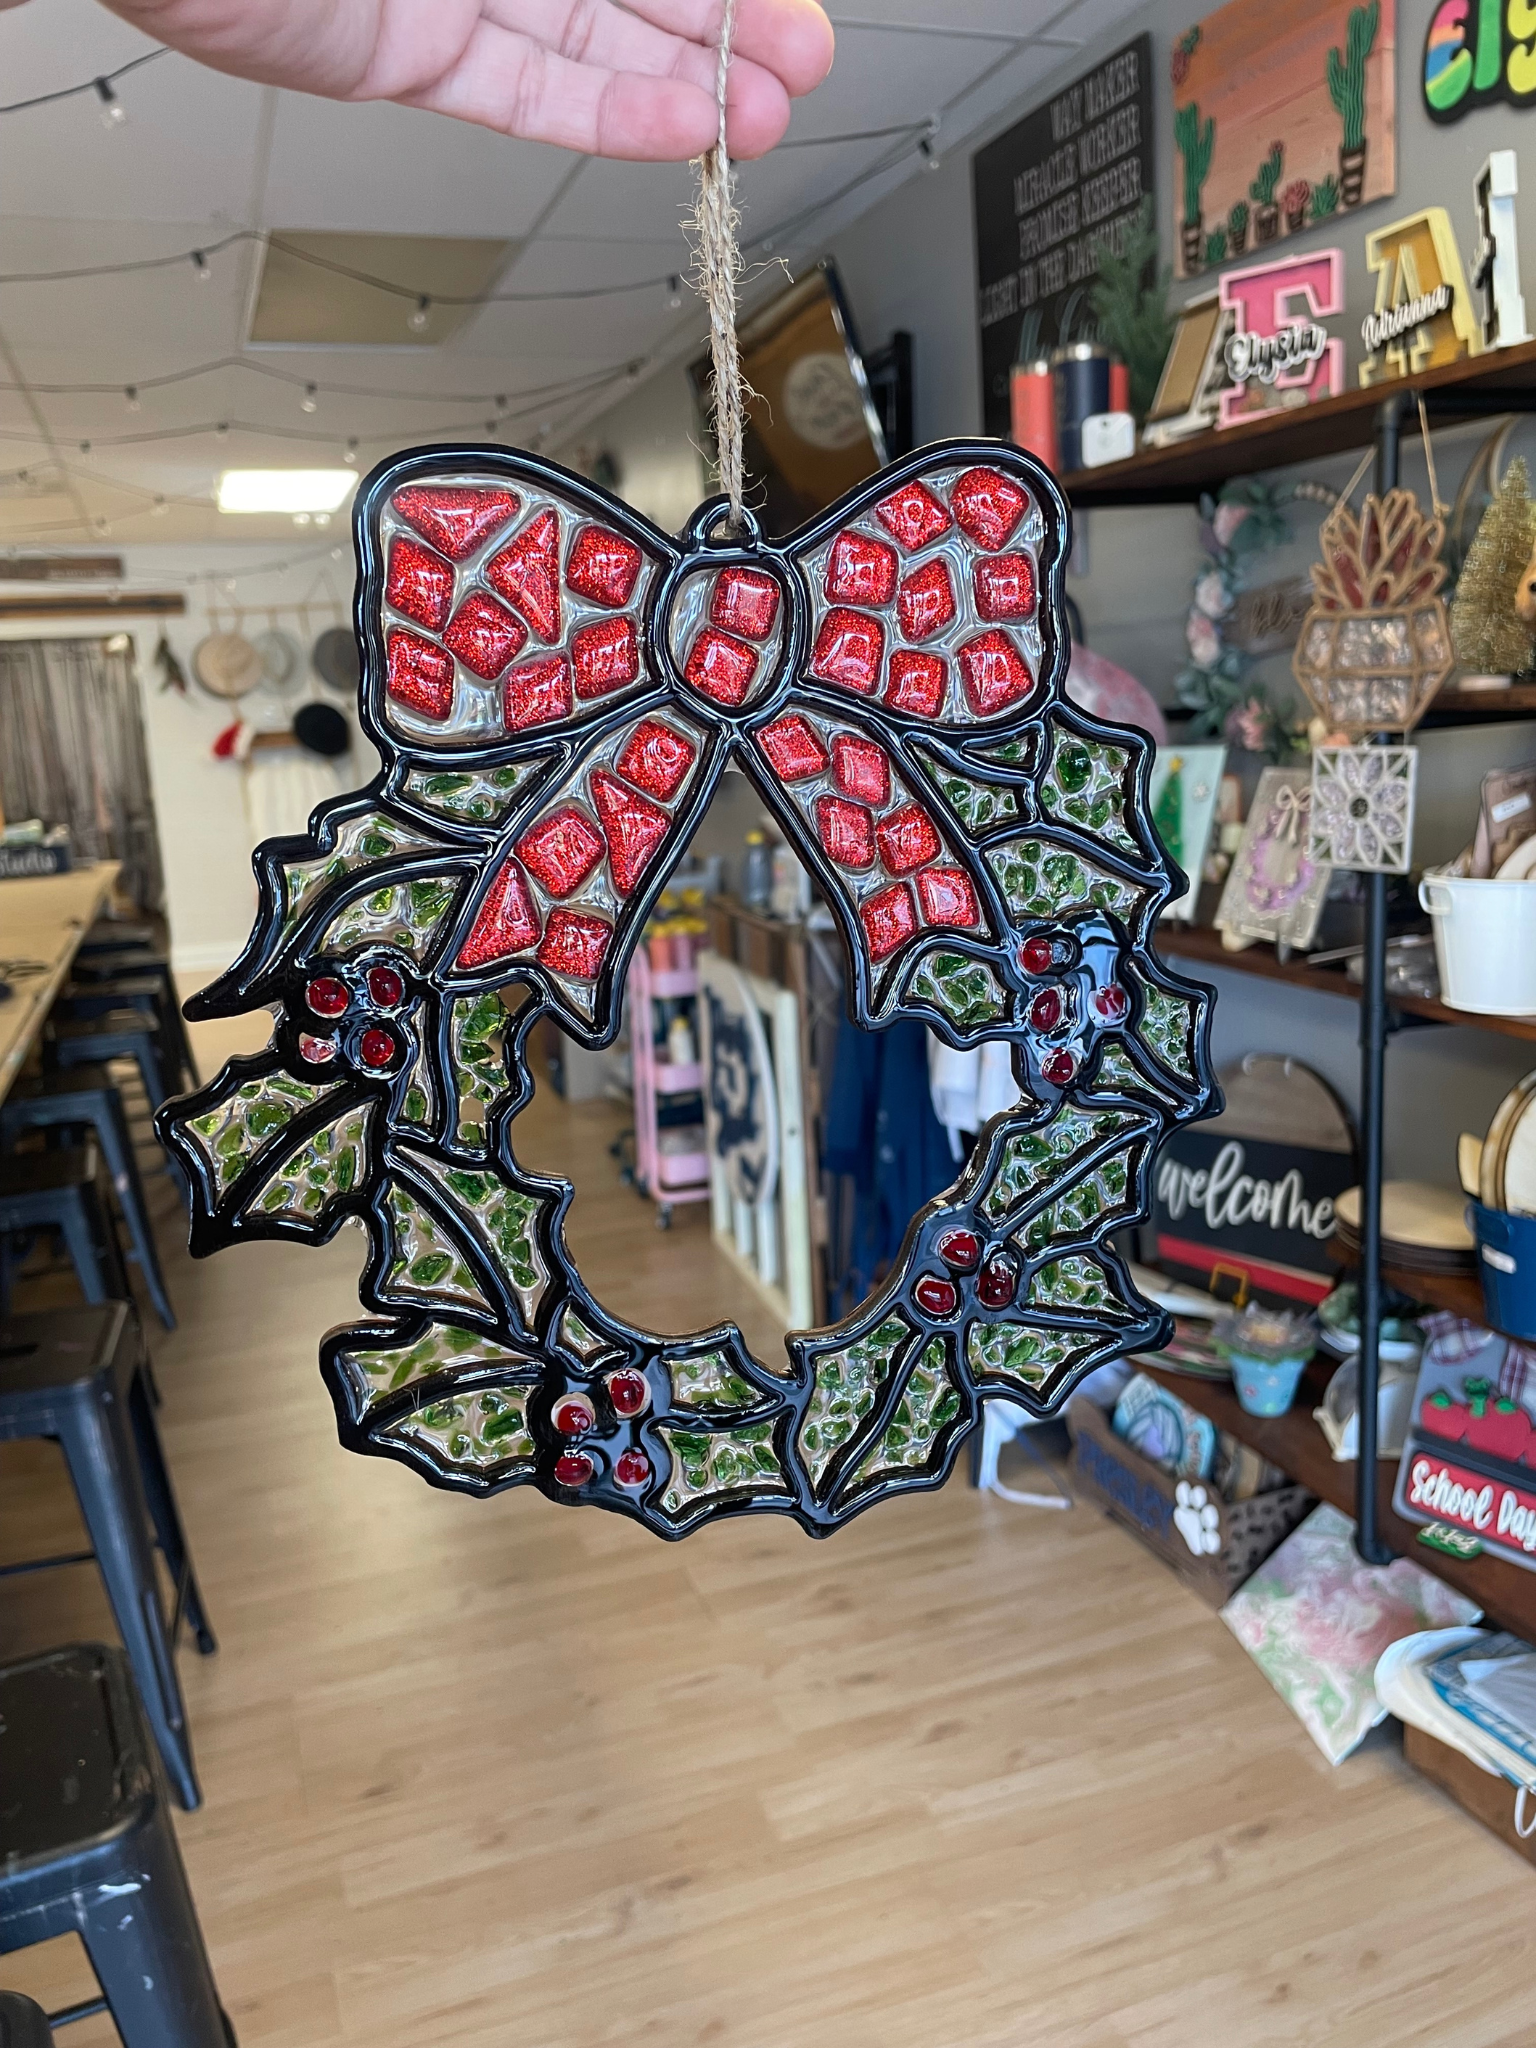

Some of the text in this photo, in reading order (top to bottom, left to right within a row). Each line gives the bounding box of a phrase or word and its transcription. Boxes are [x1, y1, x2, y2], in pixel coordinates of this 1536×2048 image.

[1083, 51, 1140, 121] MAKER
[1013, 103, 1142, 216] MIRACLE WORKER
[1018, 156, 1142, 261] PROMISE KEEPER
[1158, 1141, 1338, 1240] welcome
[1410, 1460, 1494, 1530] School
